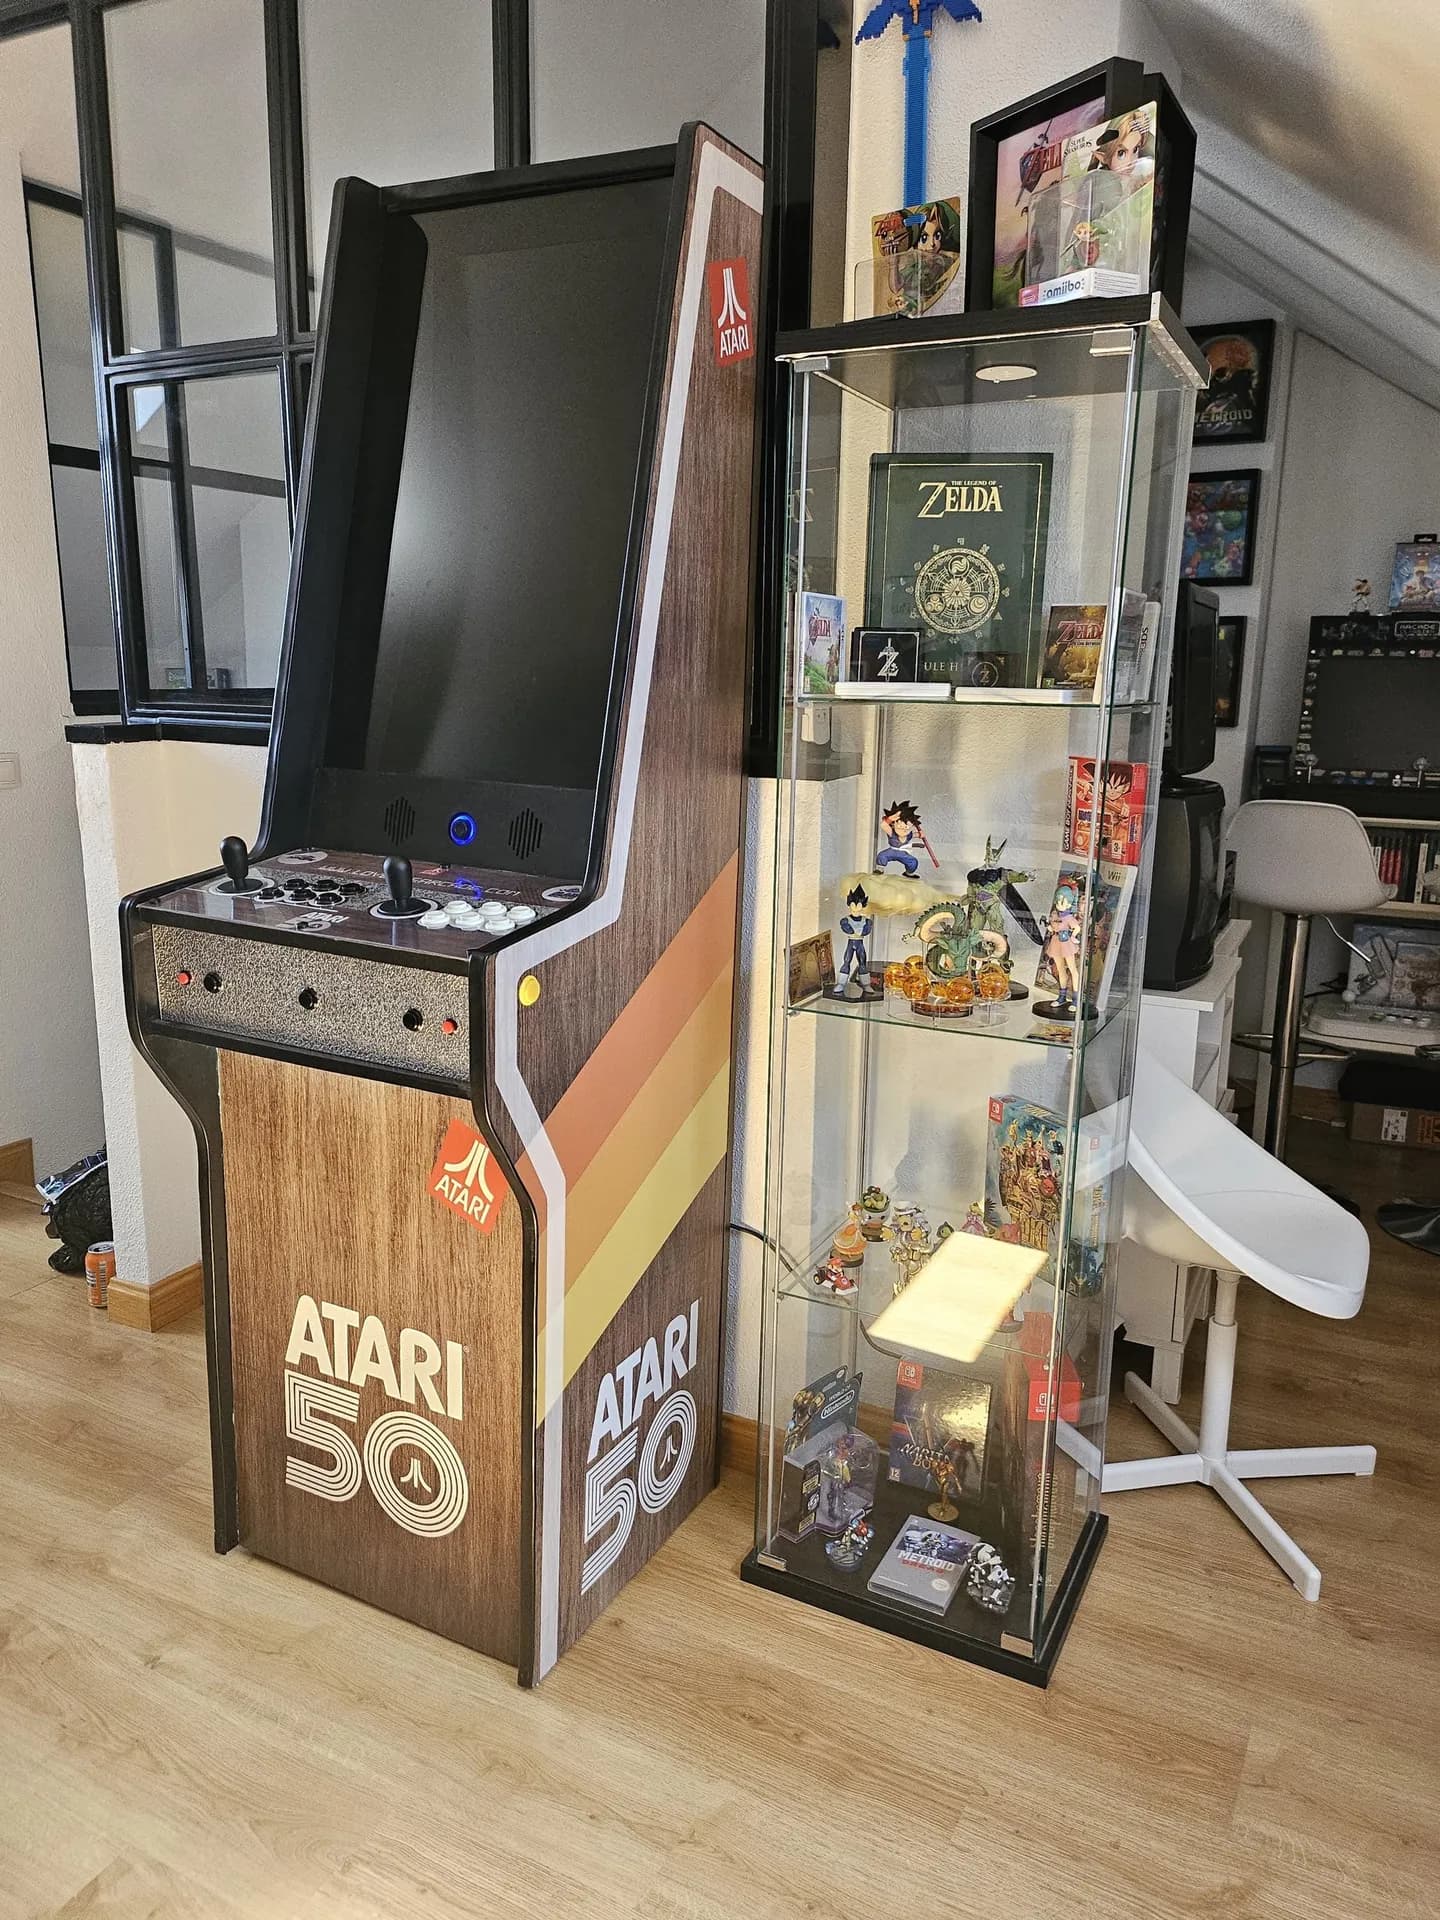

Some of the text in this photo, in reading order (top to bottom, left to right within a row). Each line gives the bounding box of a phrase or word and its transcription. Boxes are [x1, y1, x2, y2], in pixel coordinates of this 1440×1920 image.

[1046, 280, 1081, 299] amiibo
[720, 324, 750, 359] ATARI
[917, 482, 1003, 518] ZELDA
[1107, 870, 1121, 882] Wii
[300, 911, 349, 924] ATARI
[434, 1174, 490, 1225] ATARI
[285, 1294, 463, 1421] ATARI
[587, 1298, 700, 1464] ATARI
[285, 1369, 469, 1538] 50
[581, 1389, 697, 1596] 50
[897, 1549, 956, 1572] METROID
